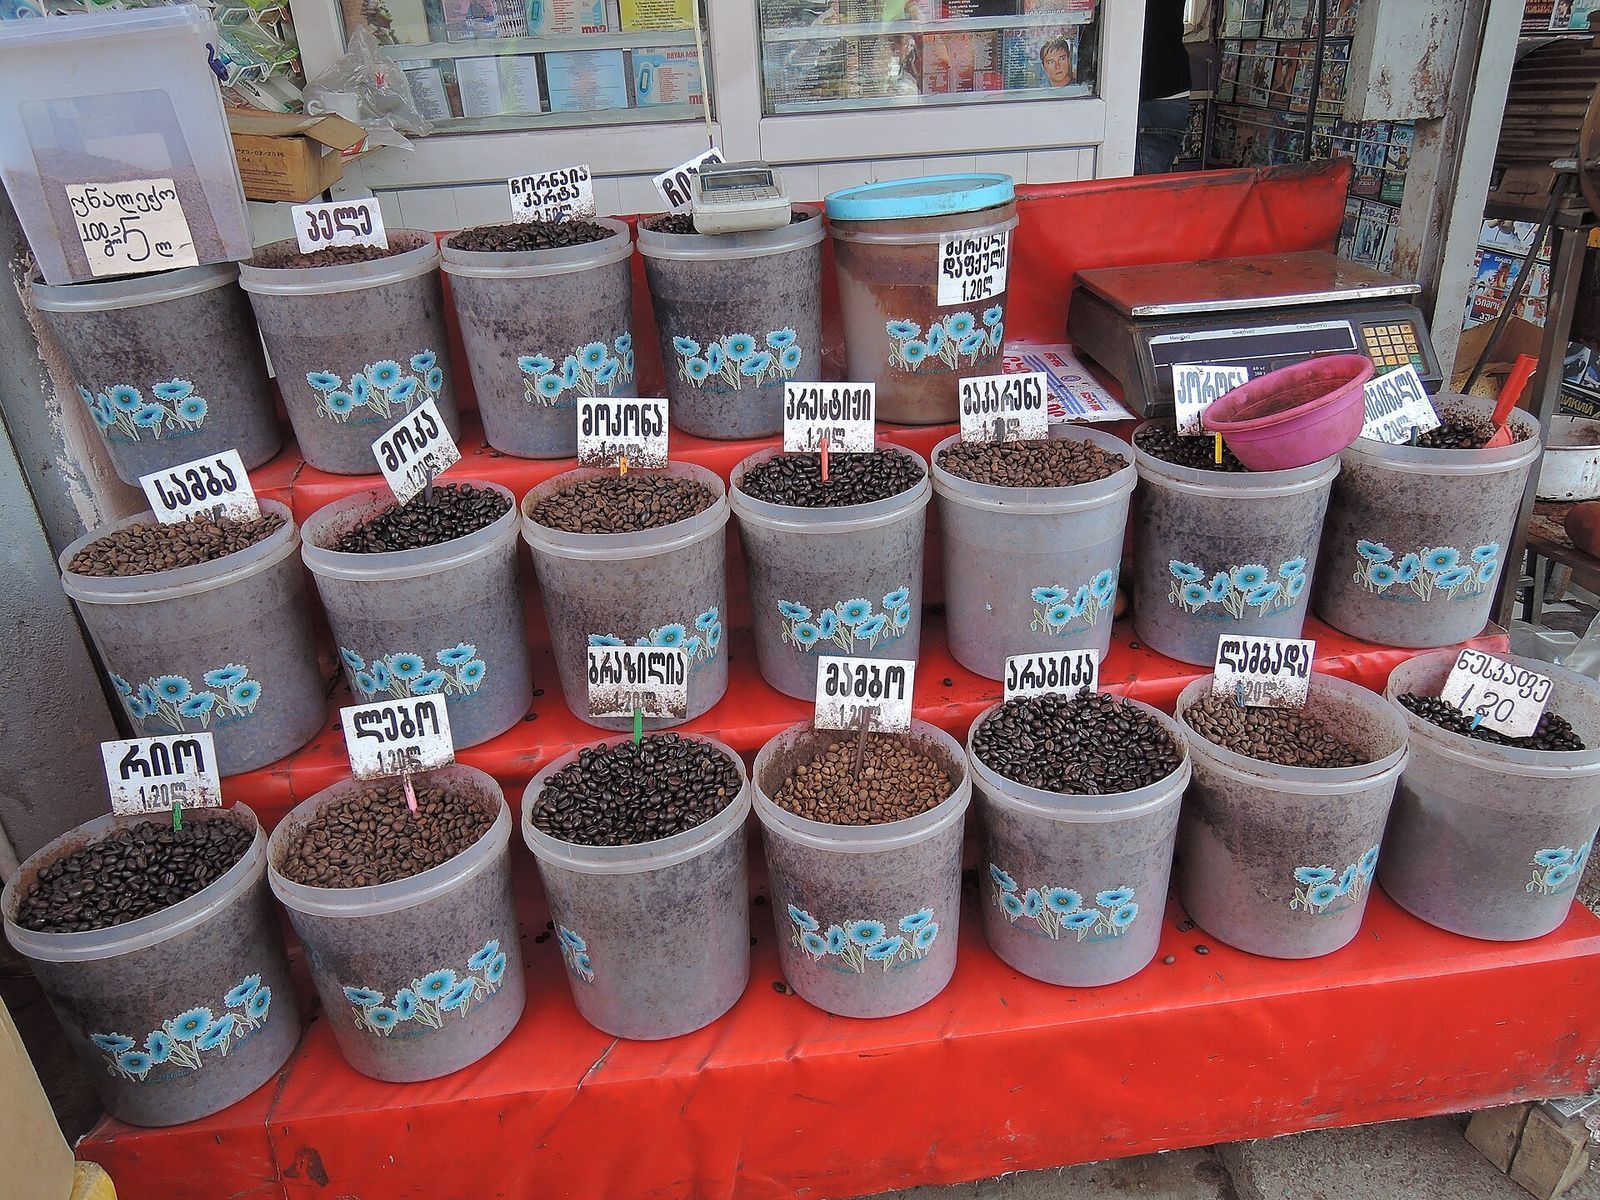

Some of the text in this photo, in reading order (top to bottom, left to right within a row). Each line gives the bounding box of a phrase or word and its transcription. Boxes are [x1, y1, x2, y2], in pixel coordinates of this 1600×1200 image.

[511, 167, 588, 195] ჩორნაია
[523, 184, 580, 208] კარტა
[82, 222, 109, 242] 100
[306, 205, 373, 242] პელე
[962, 275, 993, 302] 1.20ლ
[786, 388, 872, 421] პრესტიჟი
[963, 377, 1042, 416] მაკარენა
[582, 403, 663, 437] მოკონა
[380, 409, 439, 473] მოკა
[153, 459, 237, 510] სამბა
[589, 651, 685, 686] ბრაზილია
[1007, 653, 1093, 691] არაბიკა
[1219, 640, 1309, 679] ლამბადა
[1457, 650, 1552, 703] ნესკაფე
[826, 663, 905, 700] მამბო
[353, 700, 440, 743] ლებო
[120, 739, 205, 780] რიო
